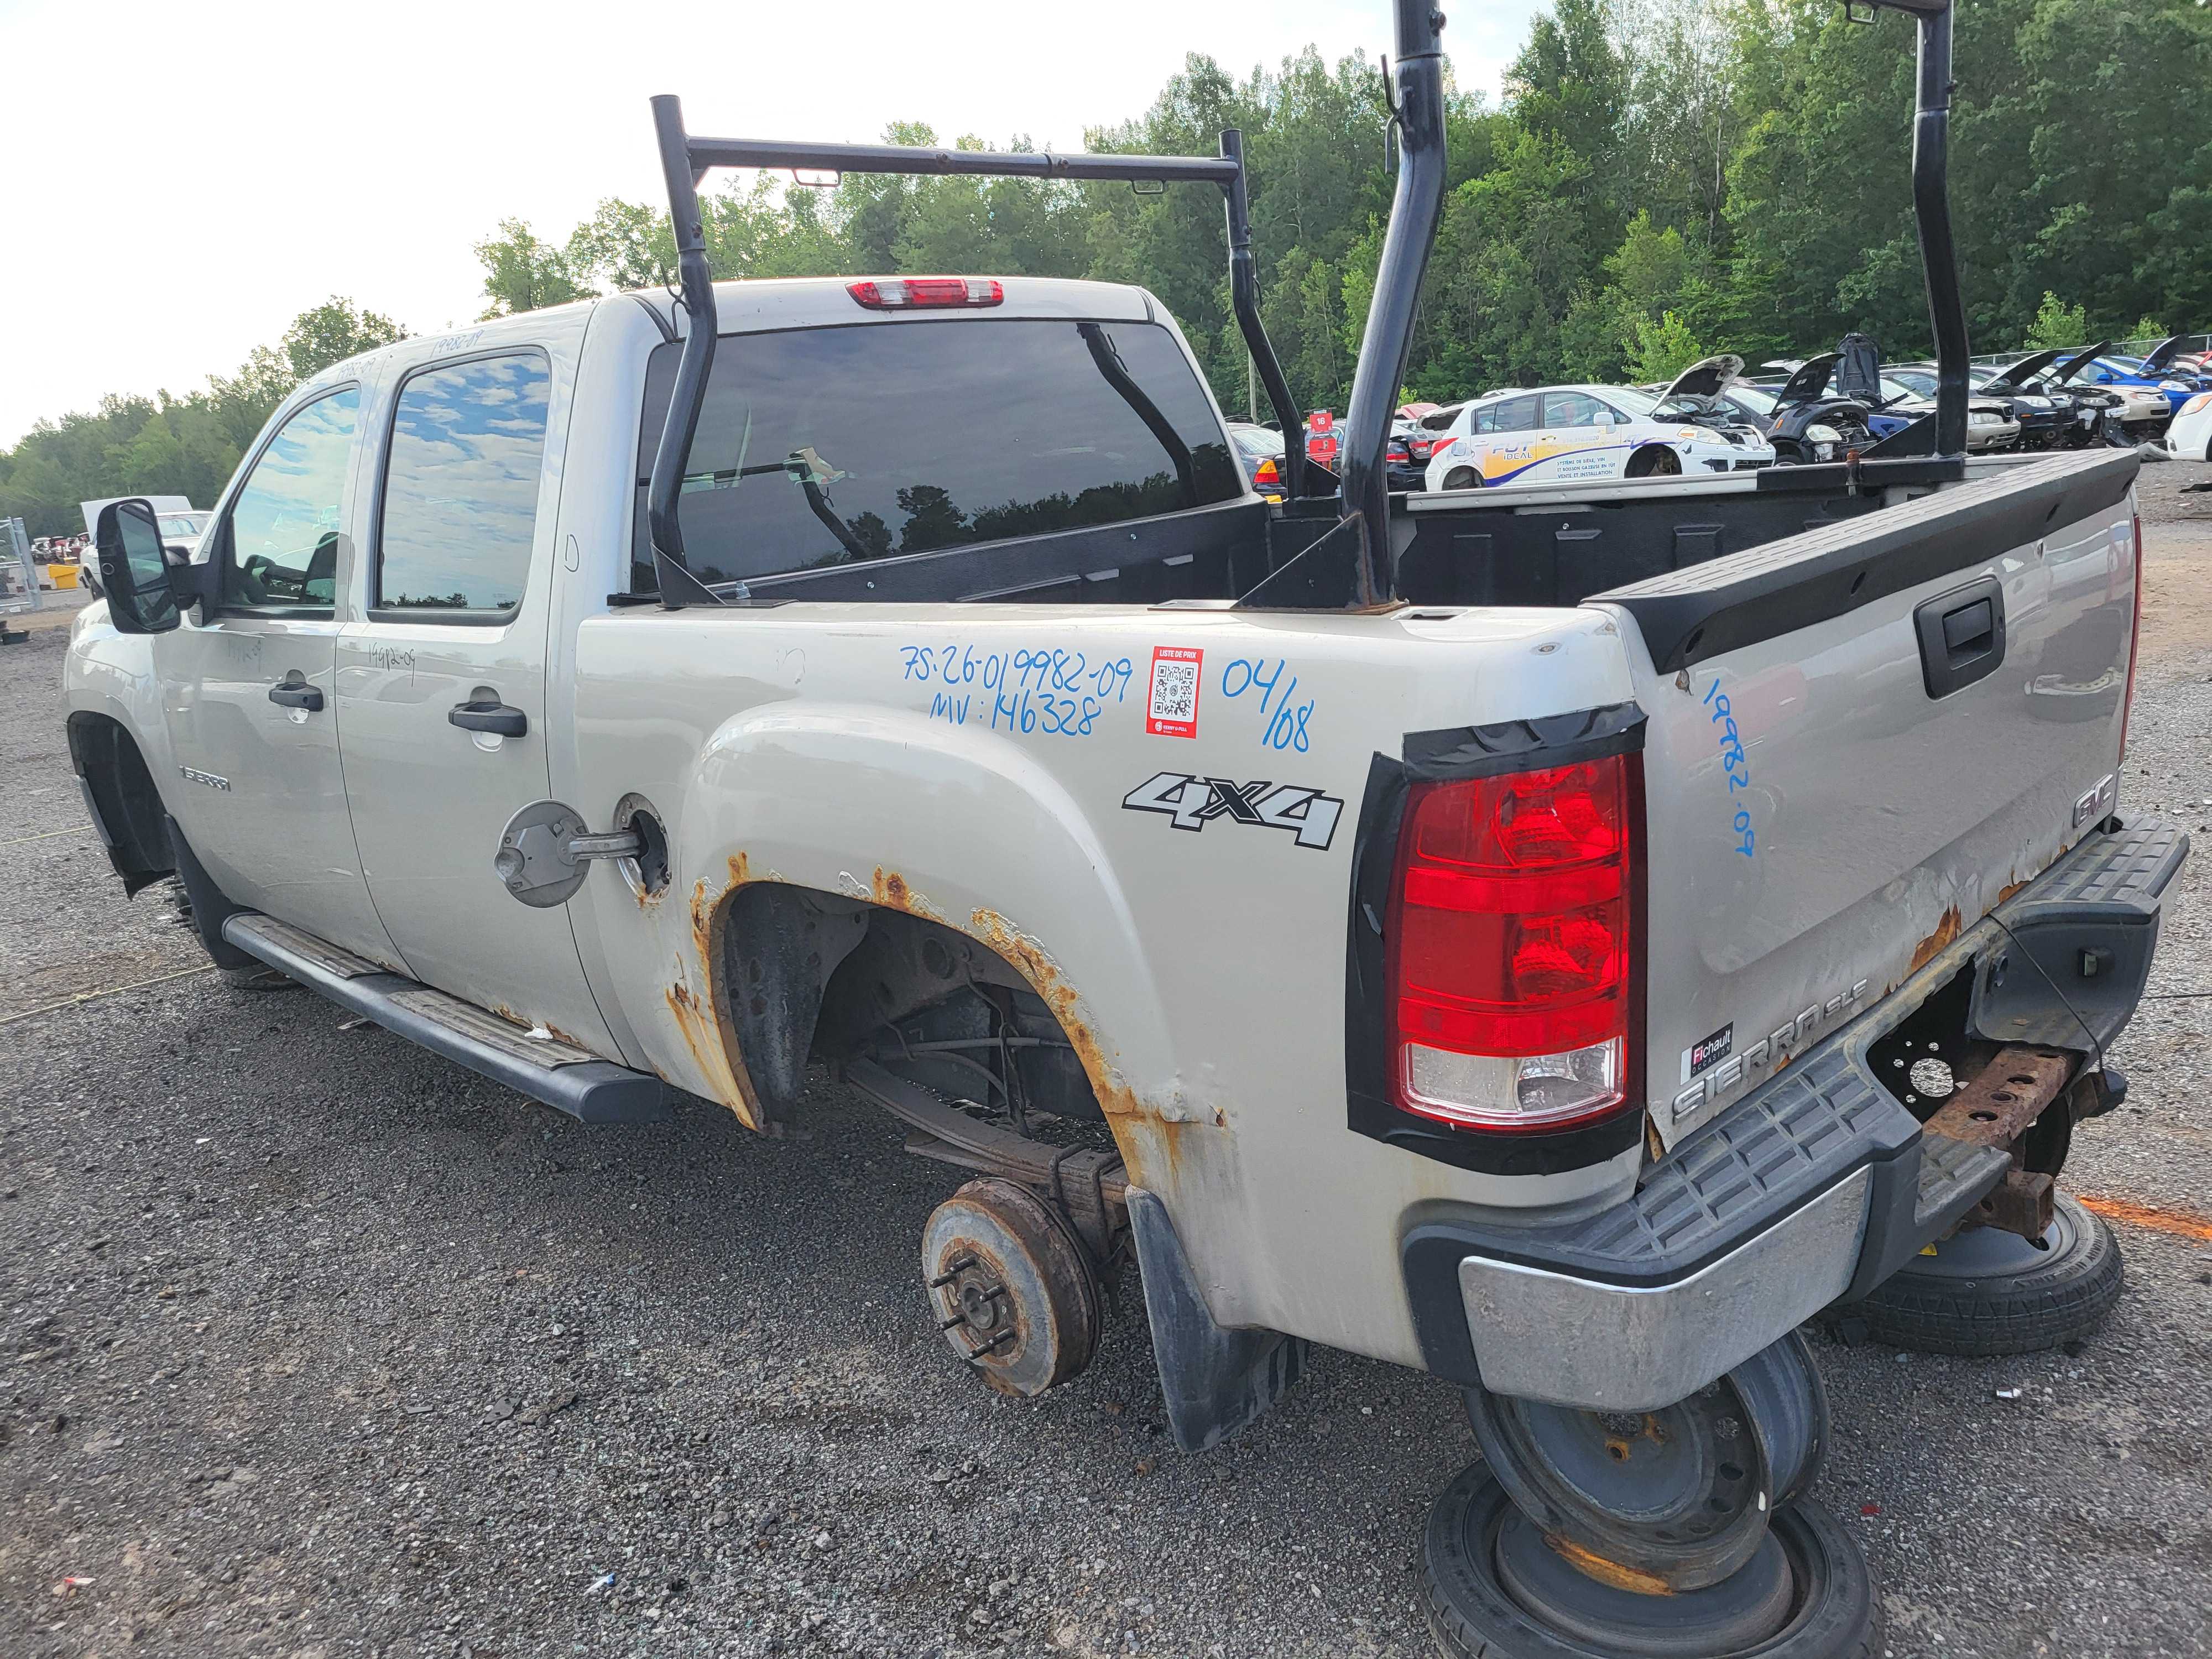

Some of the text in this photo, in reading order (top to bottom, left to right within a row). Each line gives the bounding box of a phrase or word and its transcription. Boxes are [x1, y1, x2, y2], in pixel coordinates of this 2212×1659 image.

[1316, 417, 1326, 425] 16
[991, 689, 1102, 736] 146328
[2073, 774, 2114, 828] GMC
[1672, 978, 1867, 1124] SIERRA SLE
[1692, 1045, 1731, 1074] OCCASION
[1693, 1029, 1731, 1065] Fichault
